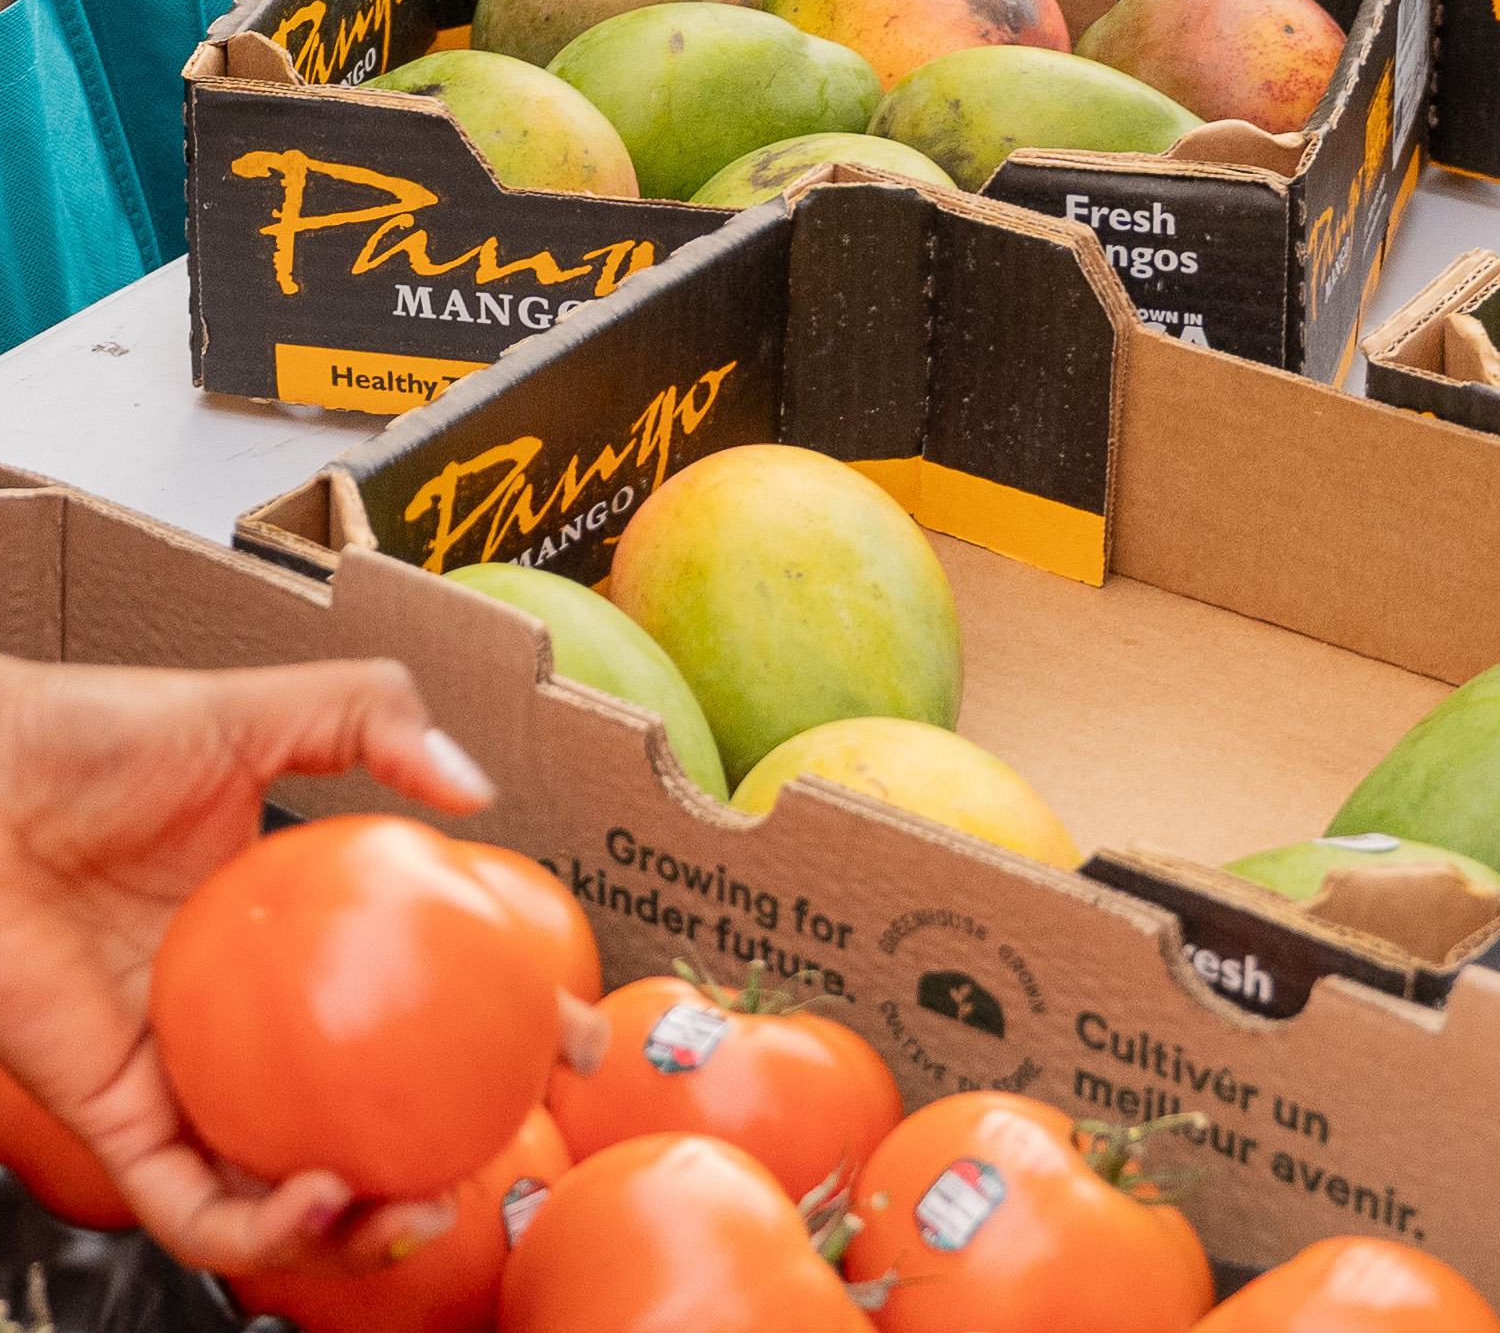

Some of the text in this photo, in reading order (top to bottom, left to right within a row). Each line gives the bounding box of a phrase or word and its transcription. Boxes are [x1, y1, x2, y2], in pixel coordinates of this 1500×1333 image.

[1065, 193, 1177, 236] Fresh
[1105, 242, 1199, 280] ngos
[1183, 312, 1204, 326] IN
[331, 363, 440, 400] Healthy
[404, 360, 738, 576] Pango
[508, 484, 636, 569] MANGO
[571, 856, 857, 1004] kinder future.
[605, 827, 856, 951] Growing for
[1180, 942, 1275, 1004] resh
[1074, 1009, 1332, 1145] Cultiver un
[1269, 1151, 1427, 1243] avenir.
